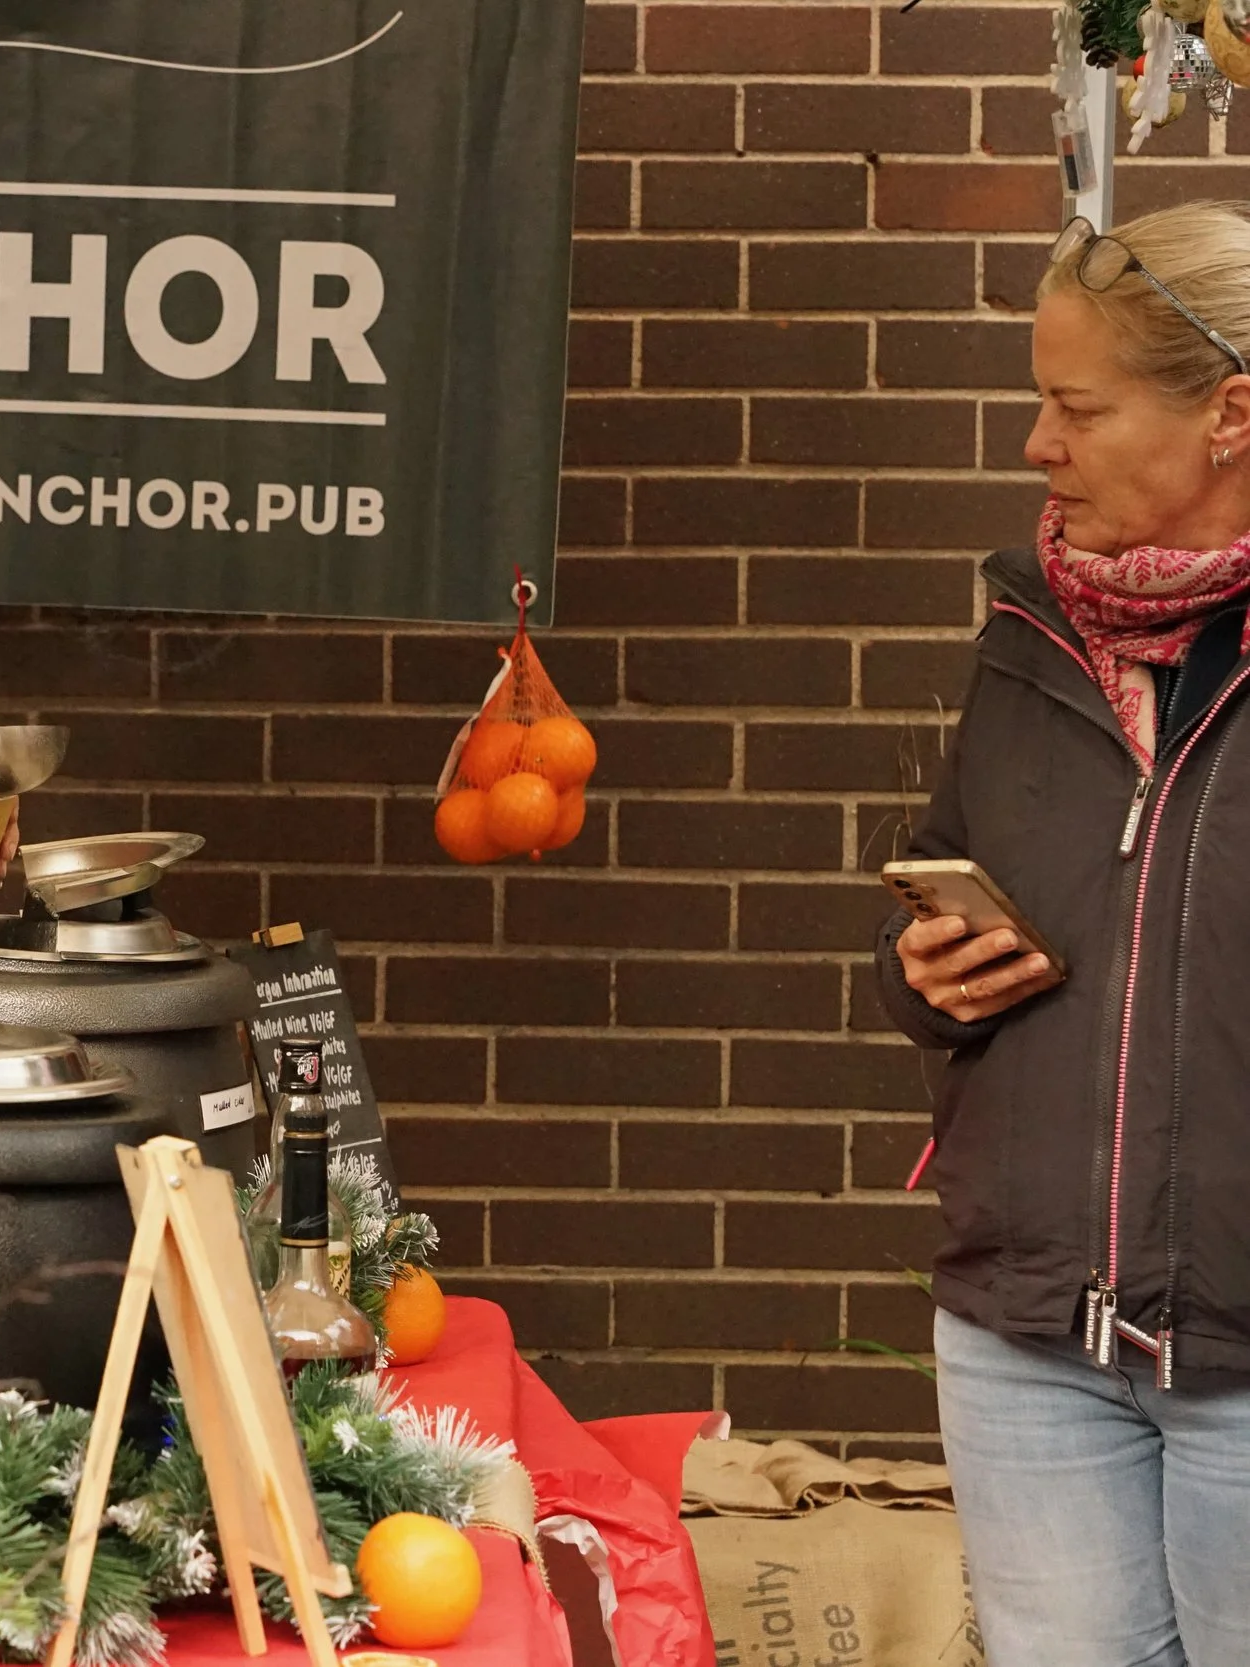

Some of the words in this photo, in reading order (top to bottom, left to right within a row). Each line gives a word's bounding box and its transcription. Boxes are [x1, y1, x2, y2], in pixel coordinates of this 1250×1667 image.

[1120, 805, 1138, 851] SUPERDRY
[254, 978, 283, 1003] ergen
[282, 964, 337, 993] Information
[253, 1019, 284, 1042] Mulled
[284, 1015, 309, 1035] Wine
[321, 1036, 347, 1061] phites
[323, 1064, 353, 1088] VG/GF
[324, 1090, 362, 1112] sulphites
[1086, 1302, 1095, 1350] SUPERDRY
[1120, 1319, 1159, 1346] UPERDRY
[1164, 1340, 1172, 1389] SUPERDRY
